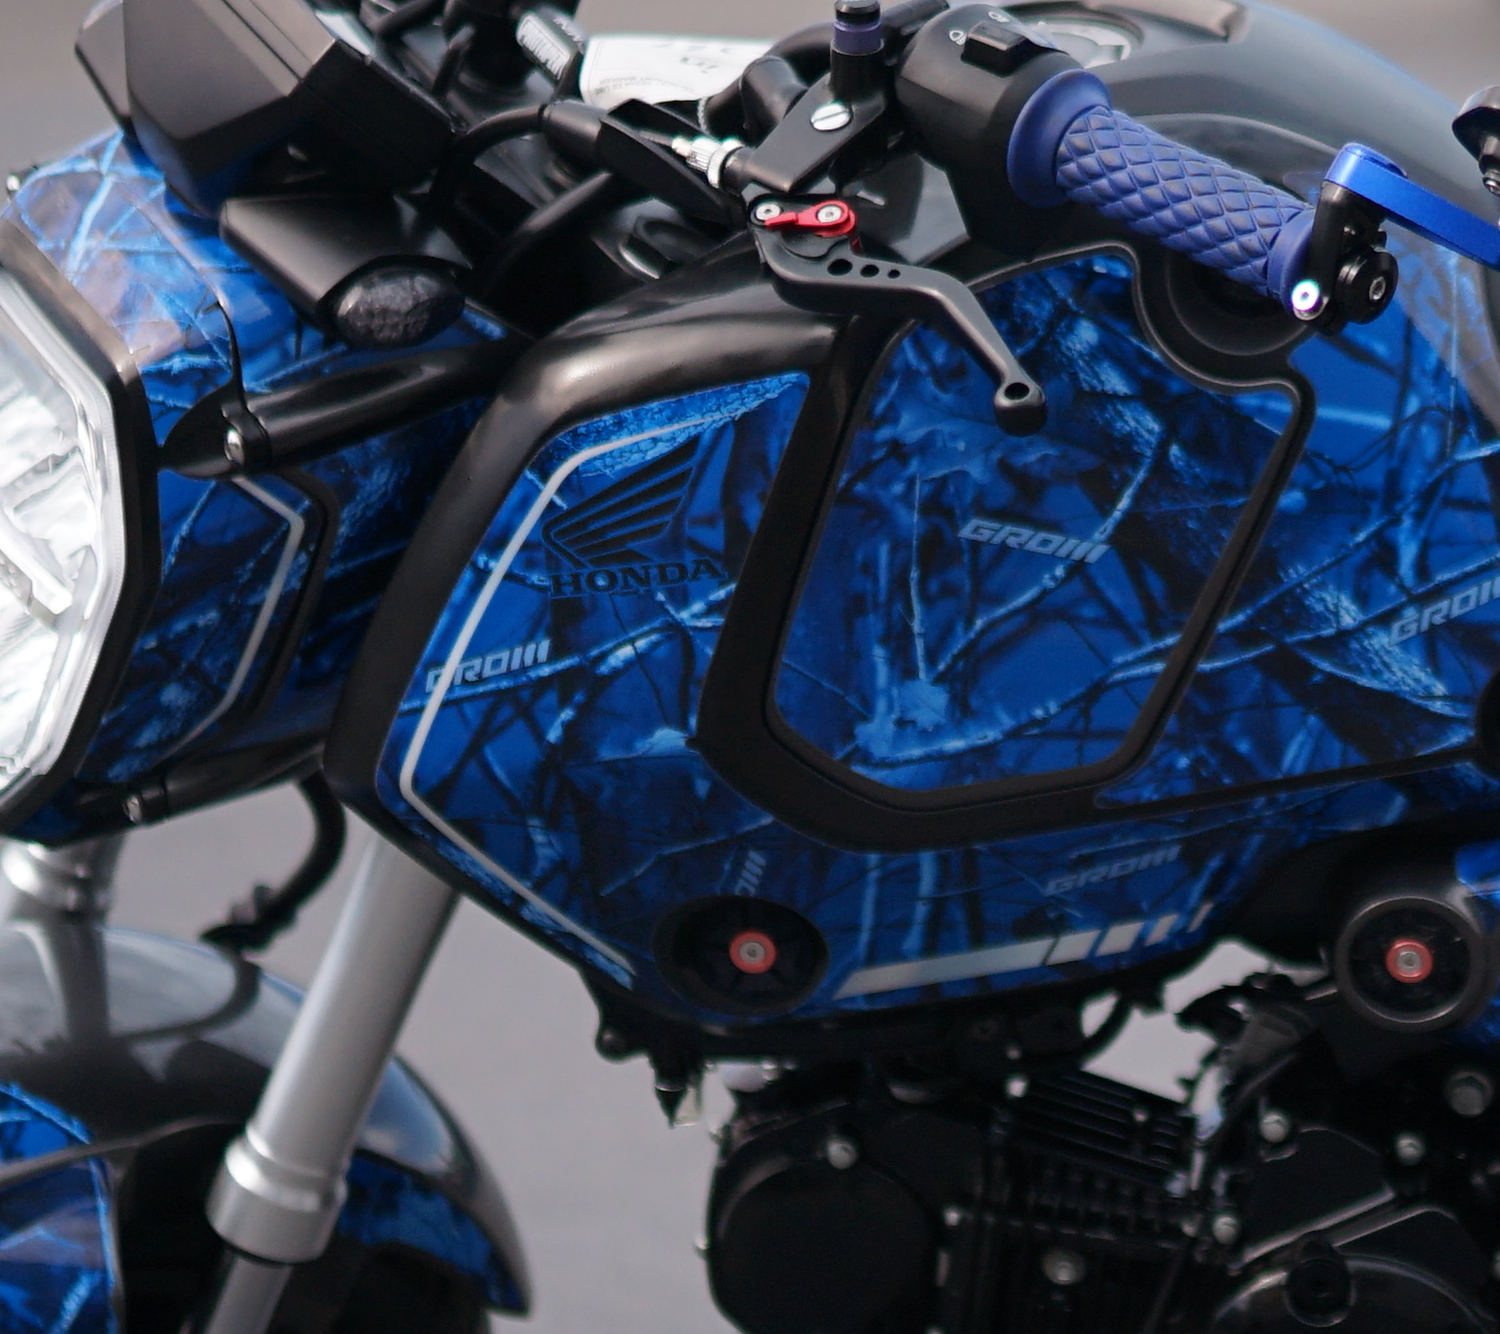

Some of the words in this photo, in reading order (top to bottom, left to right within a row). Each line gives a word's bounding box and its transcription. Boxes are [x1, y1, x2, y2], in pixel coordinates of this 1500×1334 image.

[957, 518, 1111, 565] GROM
[550, 557, 724, 596] HONDA
[1044, 844, 1183, 896] GROM
